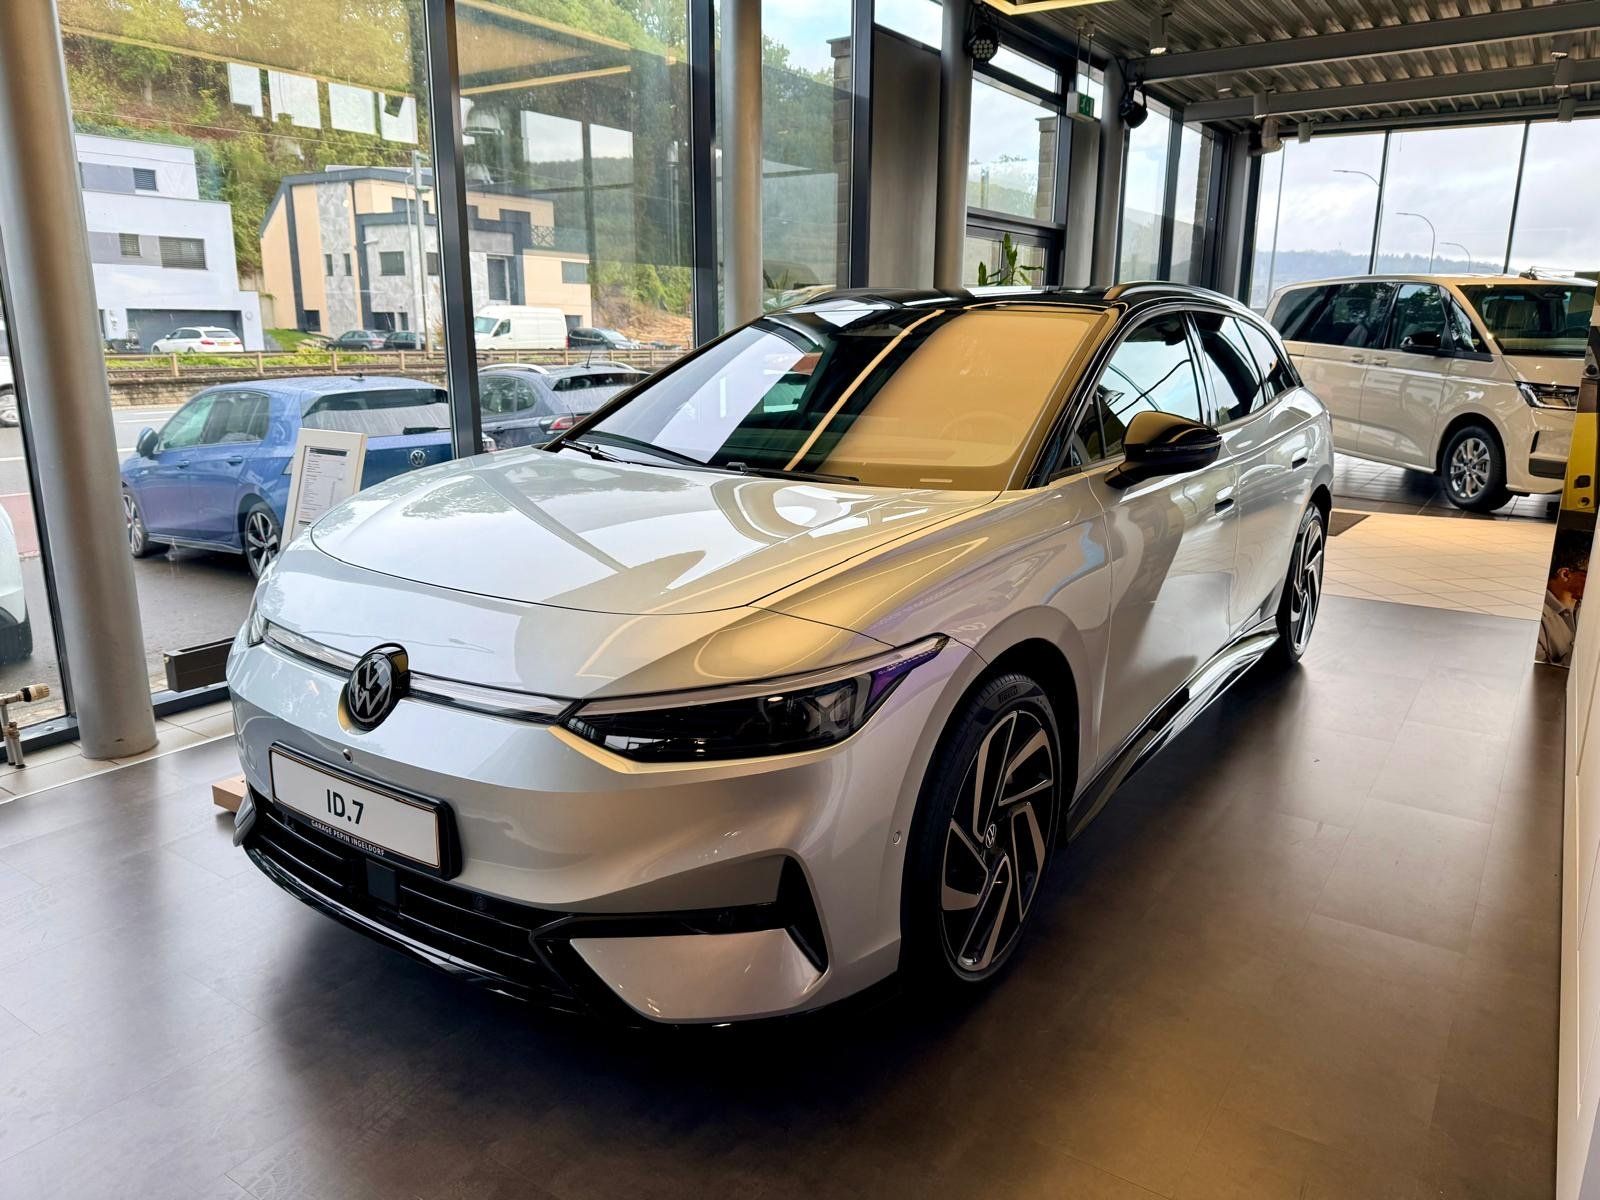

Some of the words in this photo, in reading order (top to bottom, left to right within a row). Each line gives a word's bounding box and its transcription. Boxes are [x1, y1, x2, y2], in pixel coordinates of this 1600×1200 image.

[349, 658, 392, 723] VW
[326, 788, 364, 825] ID.7
[310, 820, 332, 836] GARAGE
[333, 829, 350, 843] PEPIN
[350, 836, 385, 857] INGELDORF
